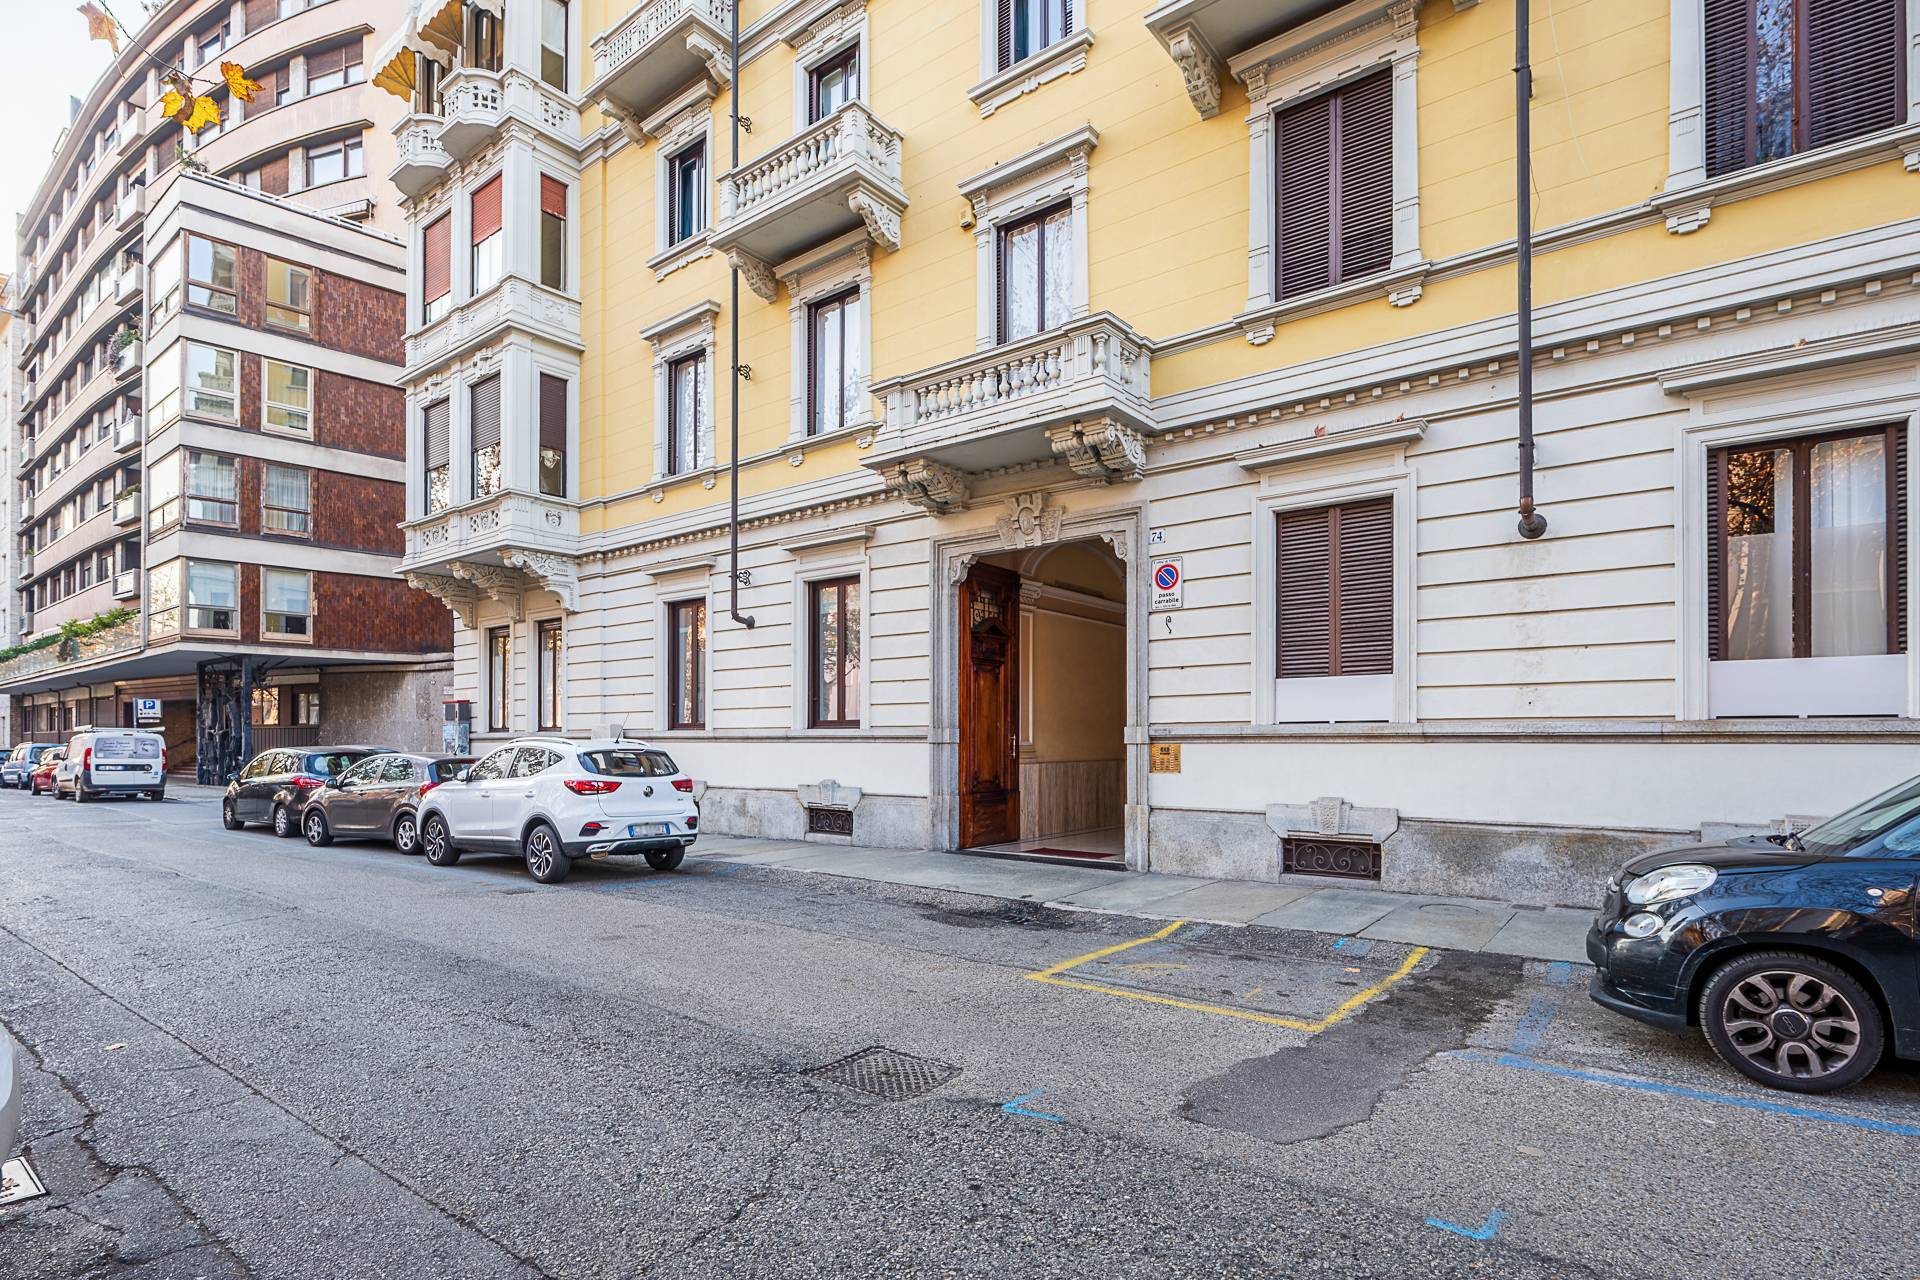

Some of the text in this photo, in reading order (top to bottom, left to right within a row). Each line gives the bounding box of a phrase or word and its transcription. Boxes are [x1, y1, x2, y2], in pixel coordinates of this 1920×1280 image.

[1151, 531, 1163, 542] 74
[1154, 597, 1180, 605] carrabile
[145, 700, 154, 709] P
